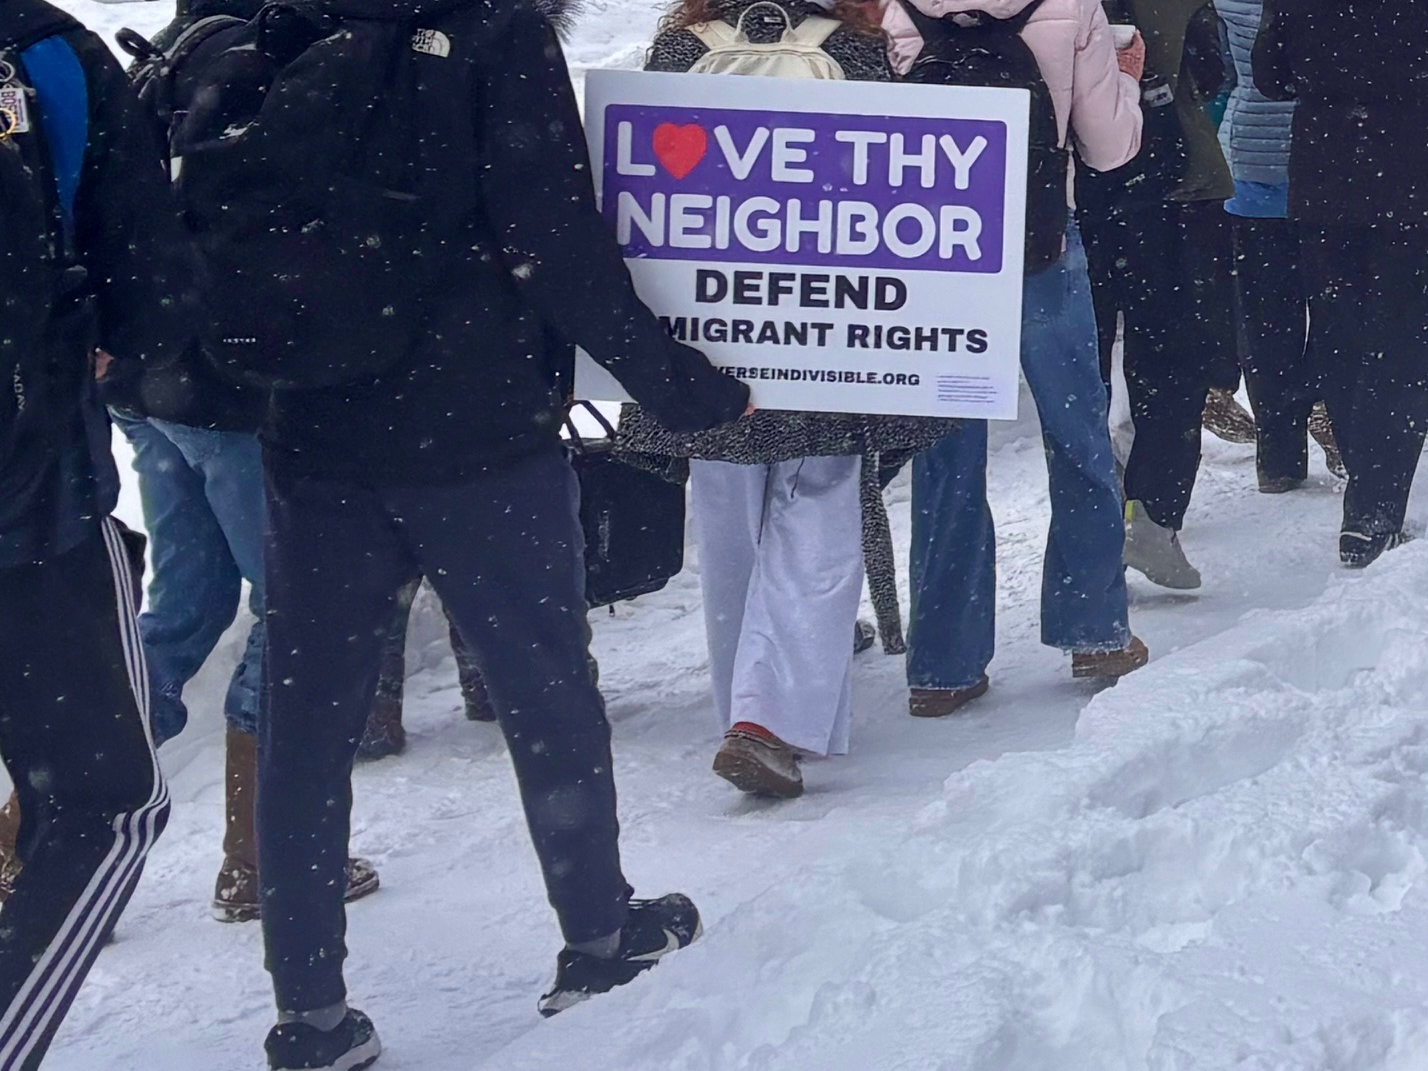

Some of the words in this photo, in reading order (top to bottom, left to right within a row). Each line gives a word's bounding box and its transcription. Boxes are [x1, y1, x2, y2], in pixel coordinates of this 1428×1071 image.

[834, 130, 988, 189] THY
[617, 191, 983, 261] NEIGHBOR
[694, 268, 907, 311] DEFEND
[659, 316, 834, 347] MIGRANT
[846, 323, 989, 353] RIGHTS
[716, 366, 920, 386] ERSEINDIVISIBLE.ORG
